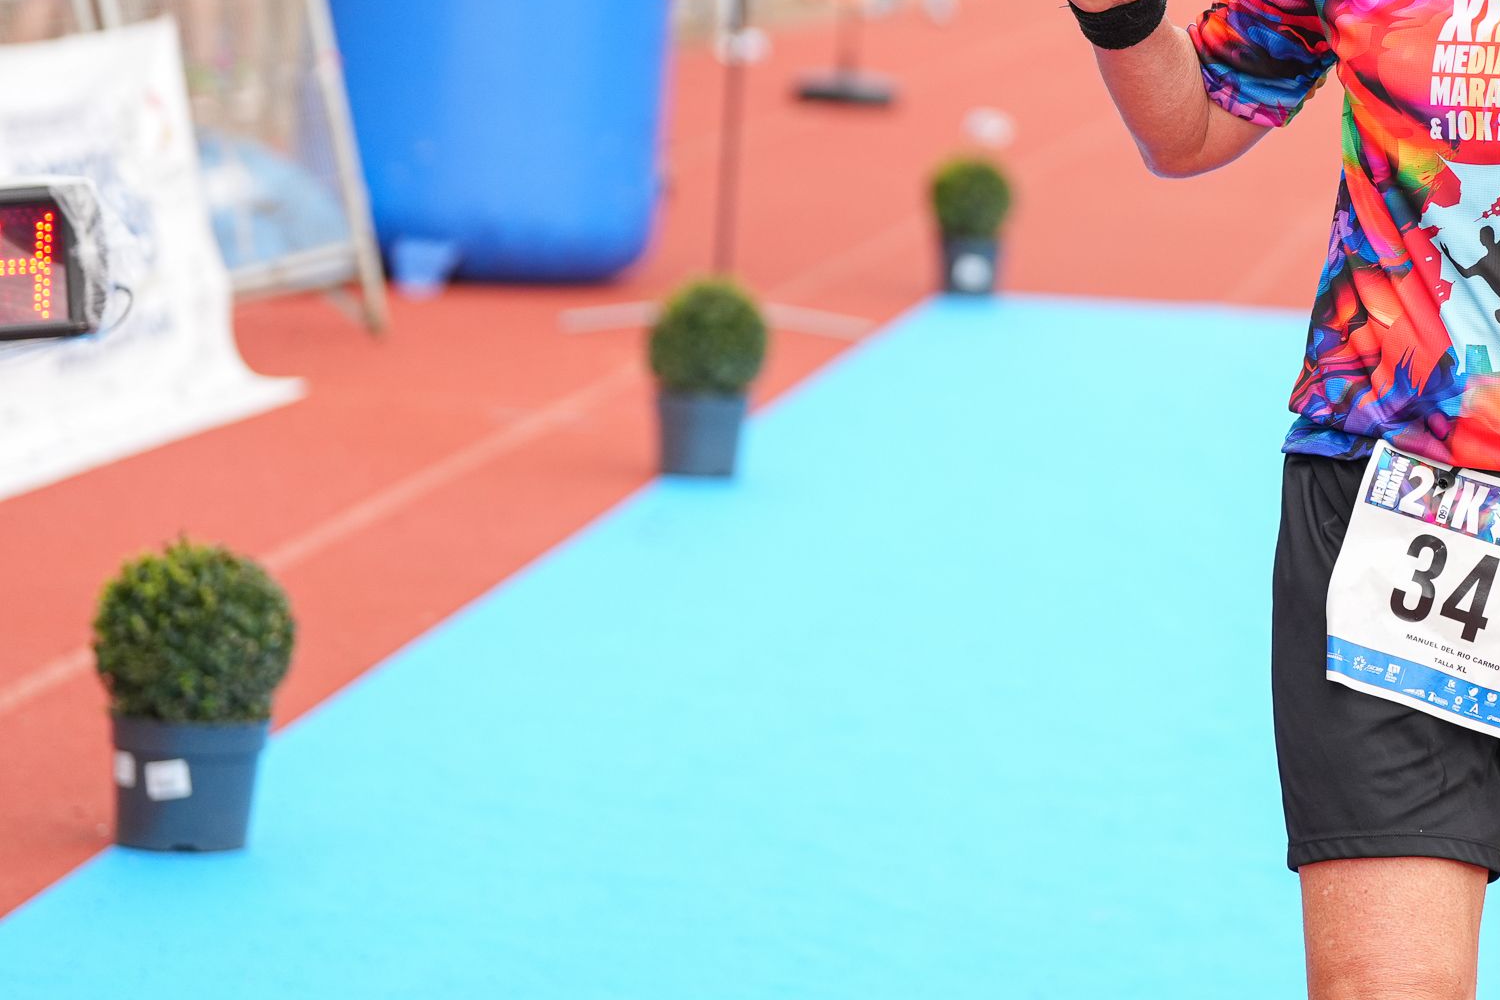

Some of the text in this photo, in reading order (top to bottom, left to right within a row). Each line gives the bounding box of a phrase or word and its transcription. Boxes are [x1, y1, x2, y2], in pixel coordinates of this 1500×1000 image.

[1430, 110, 1493, 141] & 10K
[1398, 465, 1490, 535] 21K
[1406, 633, 1438, 649] MANUEL
[1440, 645, 1455, 655] DEL
[1457, 651, 1470, 660] RIO
[1434, 657, 1467, 674] TALLA XL
